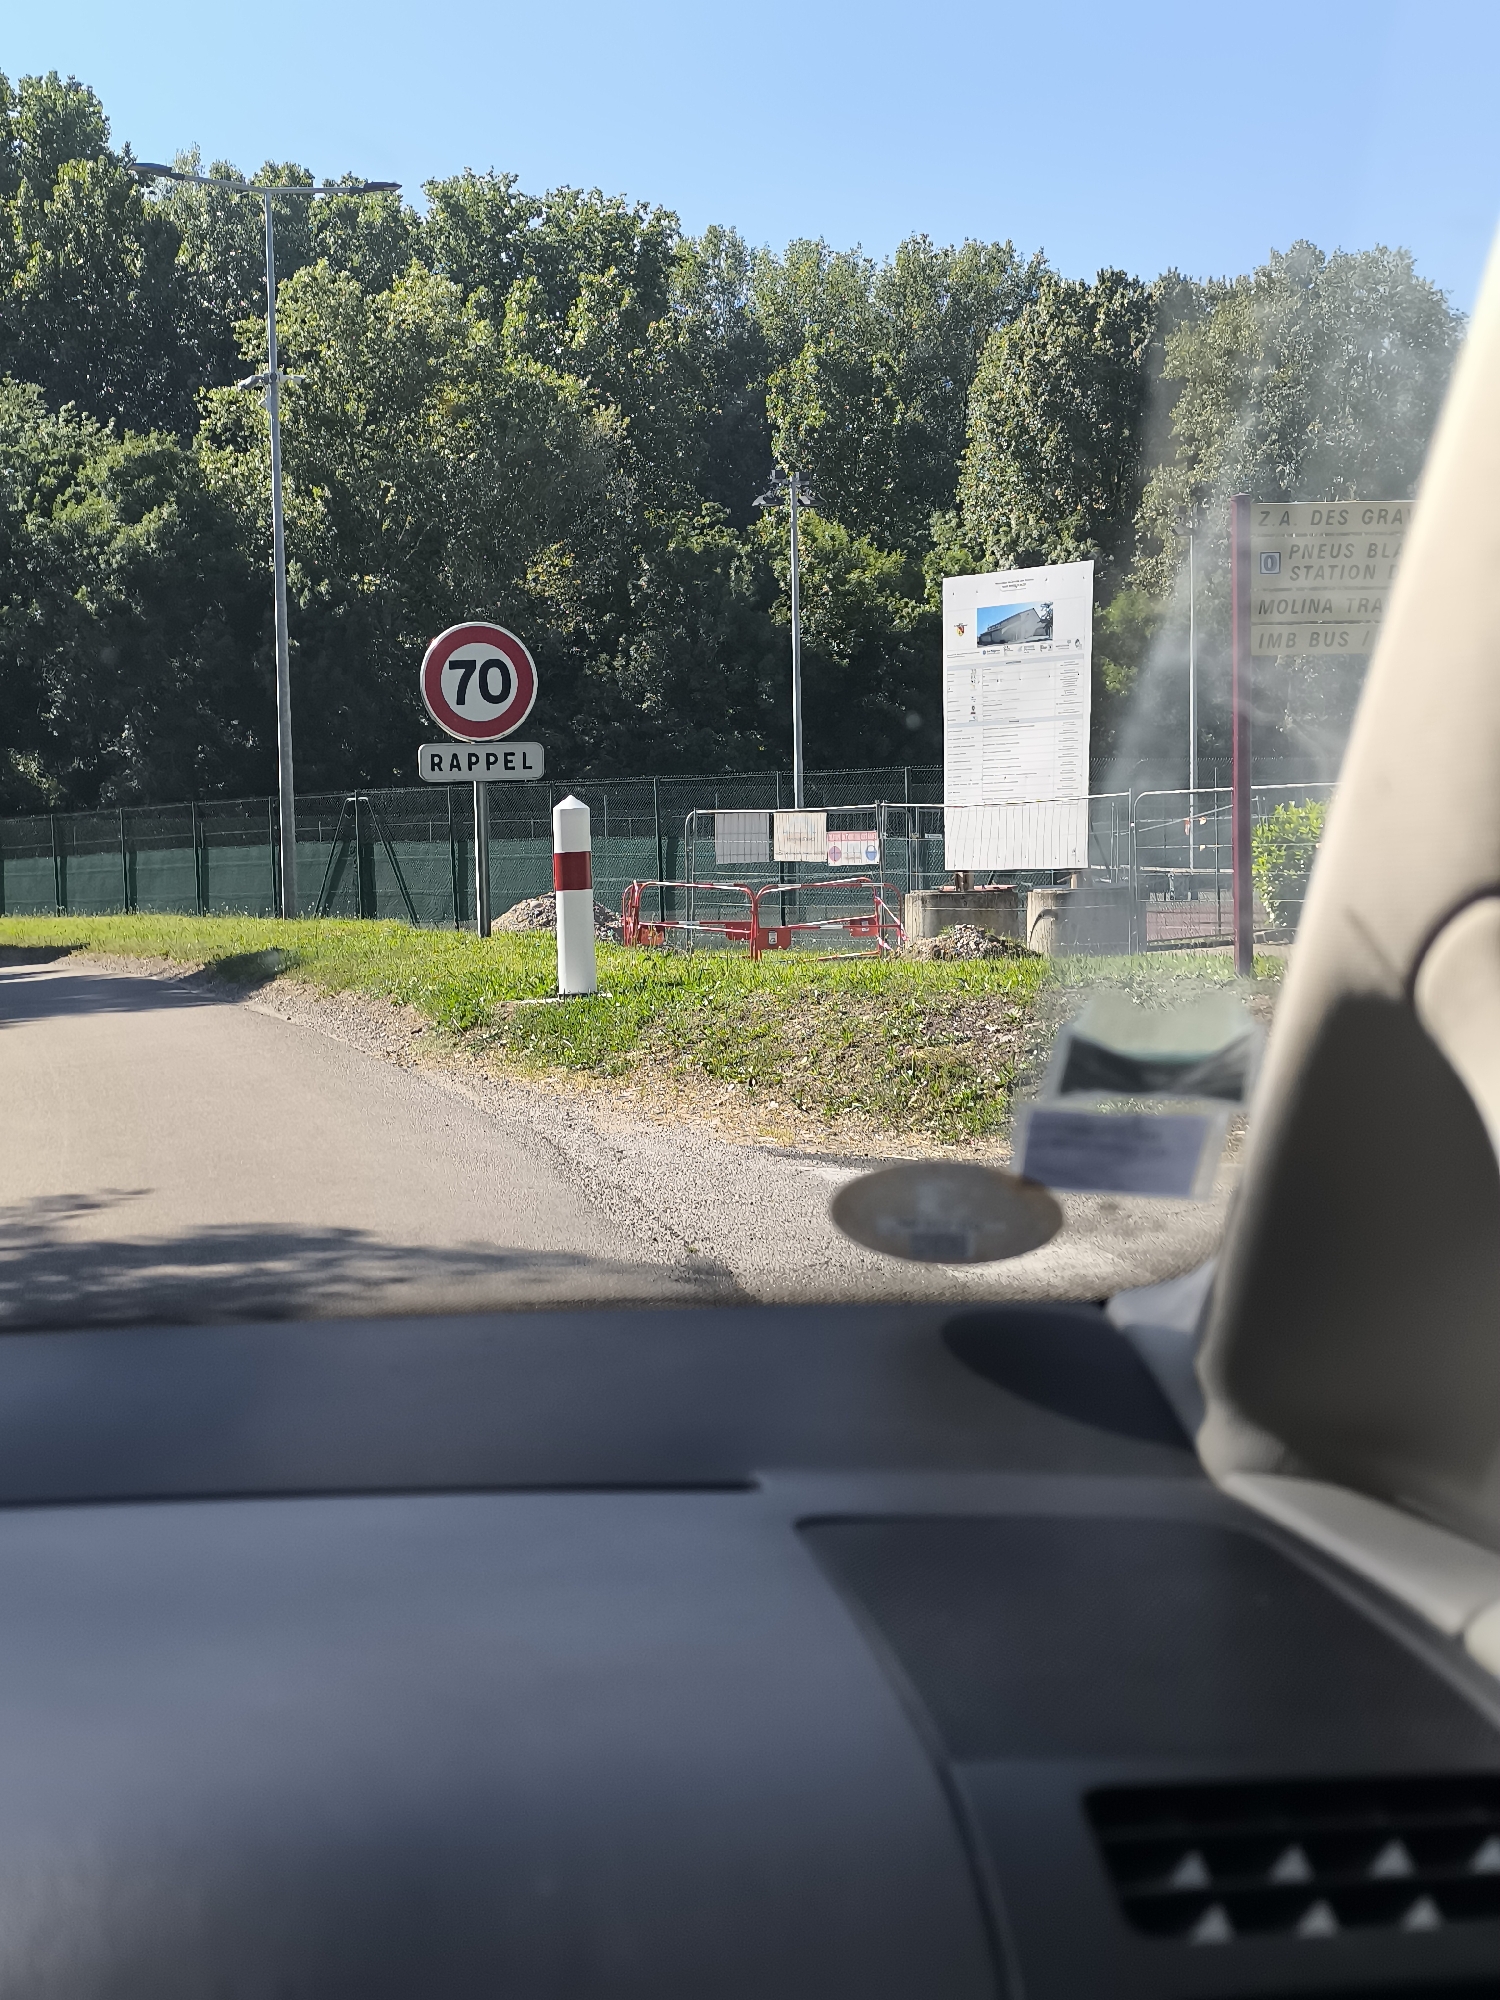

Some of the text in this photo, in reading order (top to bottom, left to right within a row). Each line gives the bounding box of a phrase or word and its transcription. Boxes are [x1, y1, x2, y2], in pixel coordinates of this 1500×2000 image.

[1310, 509, 1349, 526] DES
[1289, 542, 1355, 560] PNEUS
[1289, 564, 1376, 581] STATION
[1258, 597, 1382, 615] MOLINA TRA
[1258, 632, 1297, 649] IMB
[1308, 630, 1350, 648] BUS
[449, 658, 512, 706] 70
[430, 751, 533, 772] RAPPEL
